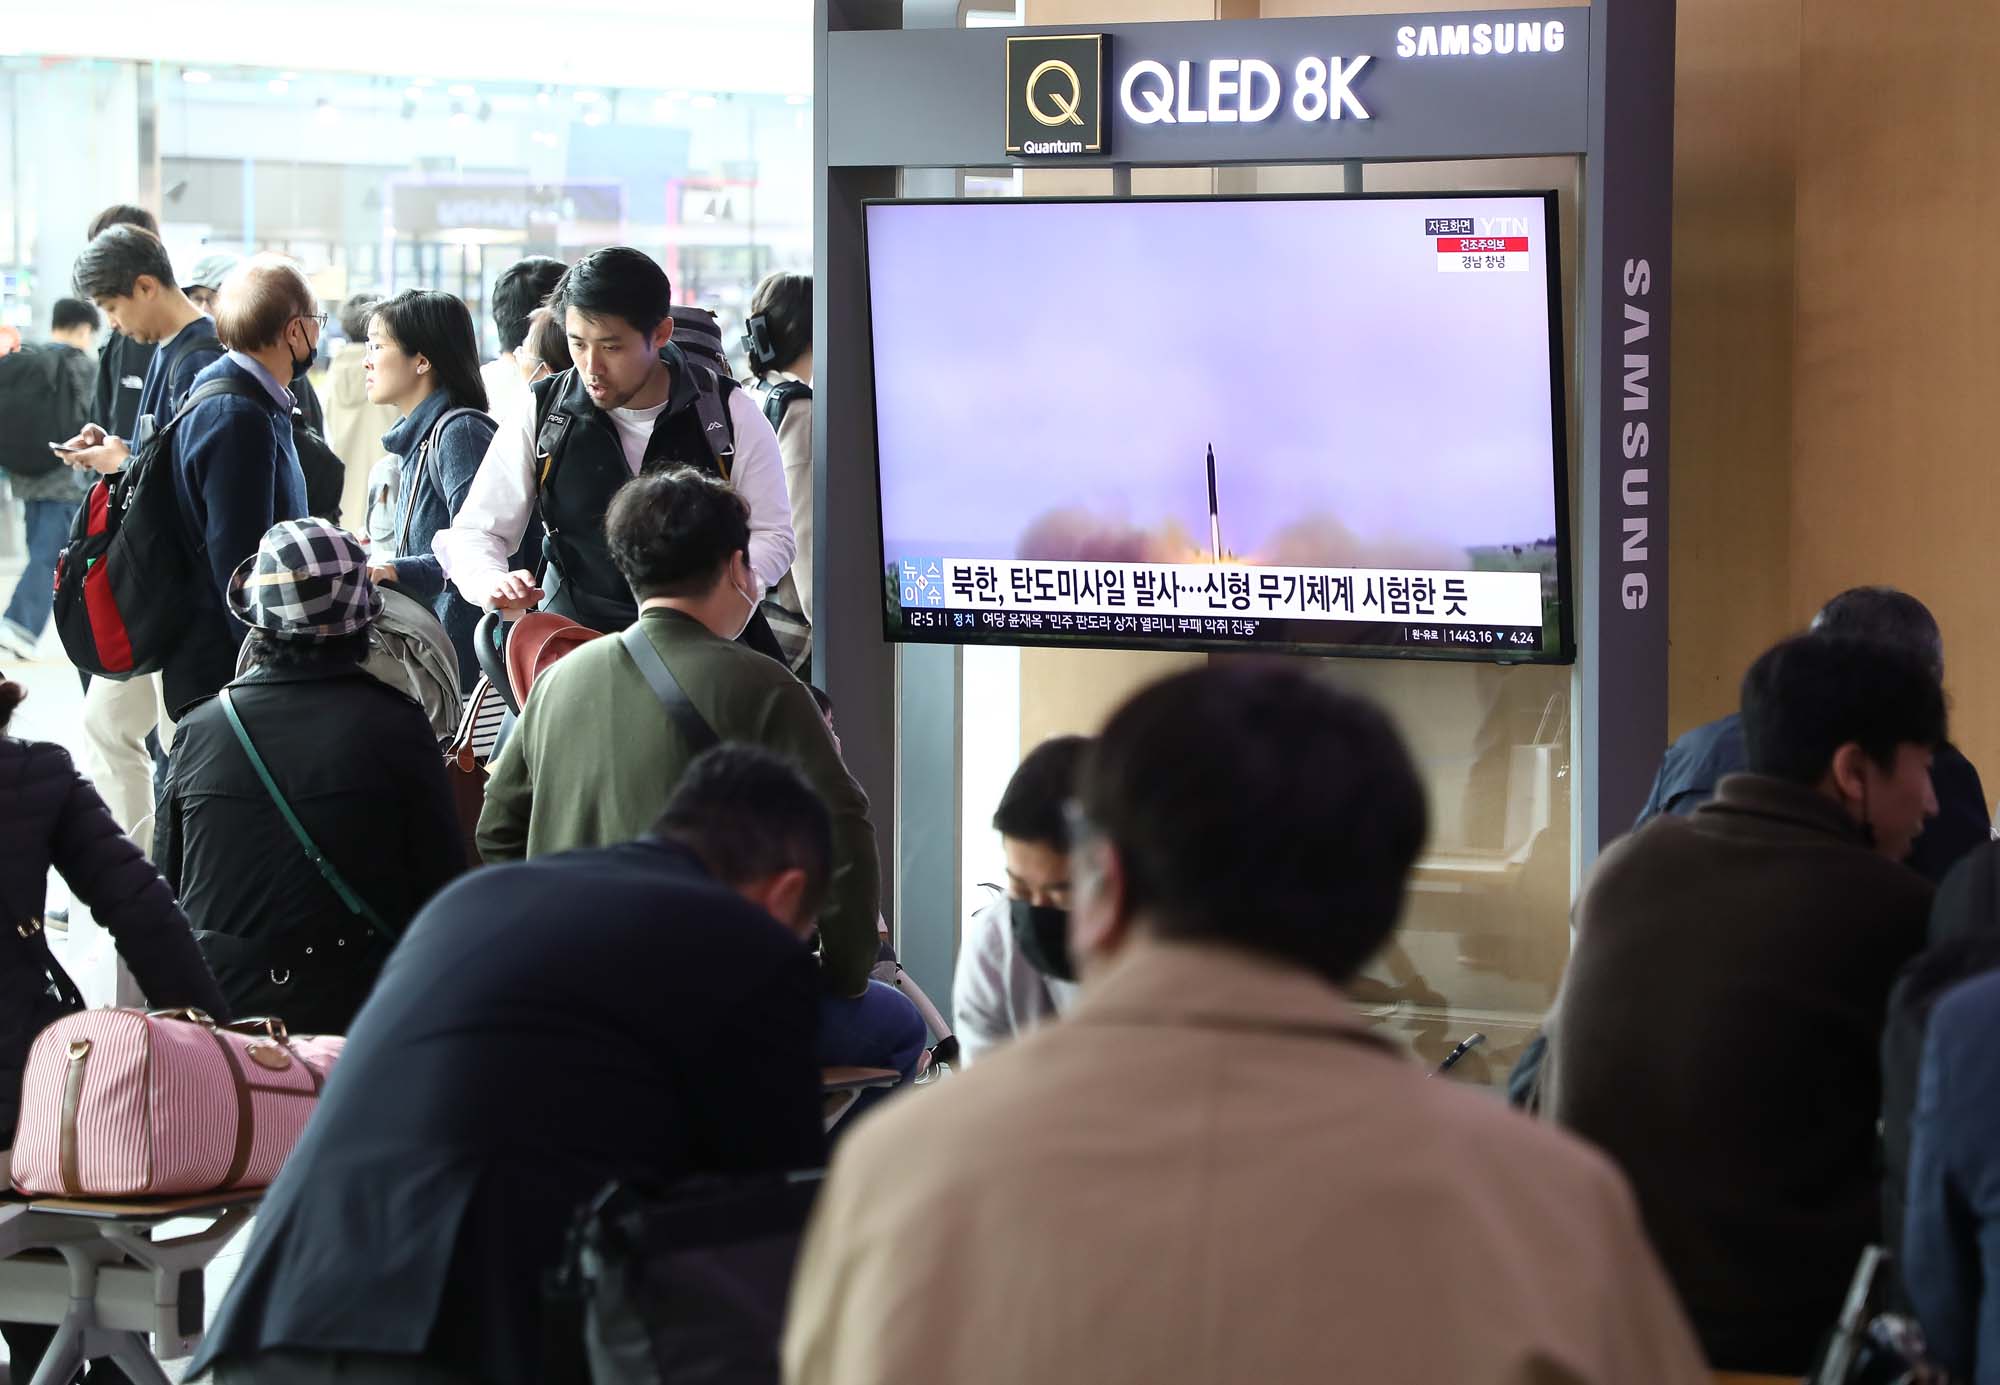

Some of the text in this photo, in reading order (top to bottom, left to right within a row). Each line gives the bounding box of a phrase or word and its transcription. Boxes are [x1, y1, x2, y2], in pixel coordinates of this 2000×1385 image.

[1396, 20, 1565, 58] SAMSUNG
[1025, 59, 1085, 127] Q
[1120, 55, 1371, 124] QLED 8K
[1023, 139, 1082, 155] Quantum
[1428, 219, 1471, 234] 자료화면
[1480, 217, 1529, 236] YTN
[1460, 239, 1506, 251] 건조주의보
[1462, 255, 1506, 269] 경남 창녕
[1622, 258, 1651, 610] SAMSUNG
[952, 565, 1005, 607] 북한,
[1010, 567, 1126, 606] 탄도미사일
[1258, 574, 1355, 614] 무기체계
[1362, 576, 1436, 615] 시험한
[1443, 579, 1468, 616] 듯
[953, 613, 975, 627] 정치
[982, 612, 1006, 628] 여당
[1008, 613, 1043, 629] 윤재옥
[1045, 614, 1074, 630] "민주
[1075, 615, 1111, 630] 판도라
[1113, 616, 1137, 632] 상자
[1139, 617, 1175, 633] 열리니
[1178, 618, 1202, 634] 부패
[1231, 620, 1260, 636] 진동"
[1411, 628, 1535, 644] 원-유로 1443.16 4.24
